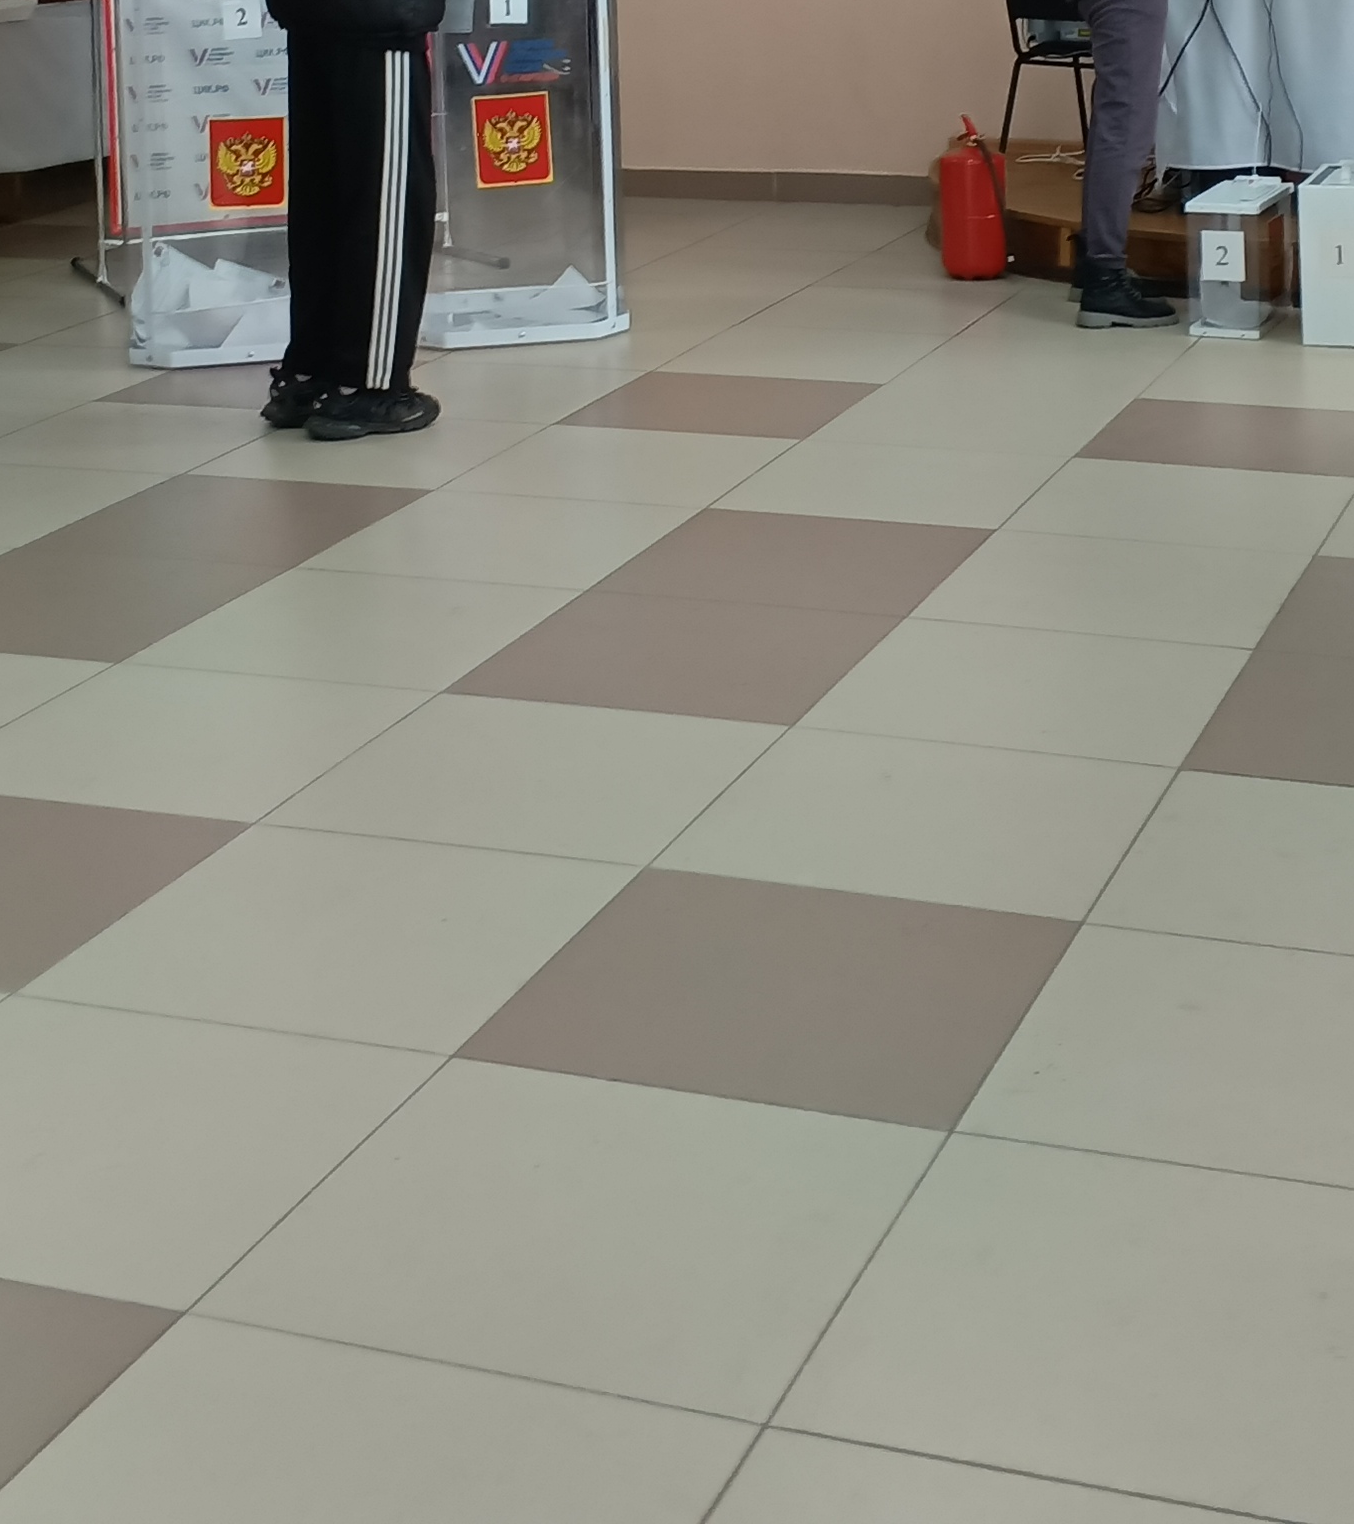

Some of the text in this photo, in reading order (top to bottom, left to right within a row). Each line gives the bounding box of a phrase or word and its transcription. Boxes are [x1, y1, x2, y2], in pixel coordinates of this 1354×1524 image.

[235, 7, 248, 26] 2
[505, 0, 511, 16] 1
[1215, 245, 1230, 266] 2
[1335, 244, 1344, 265] 1
